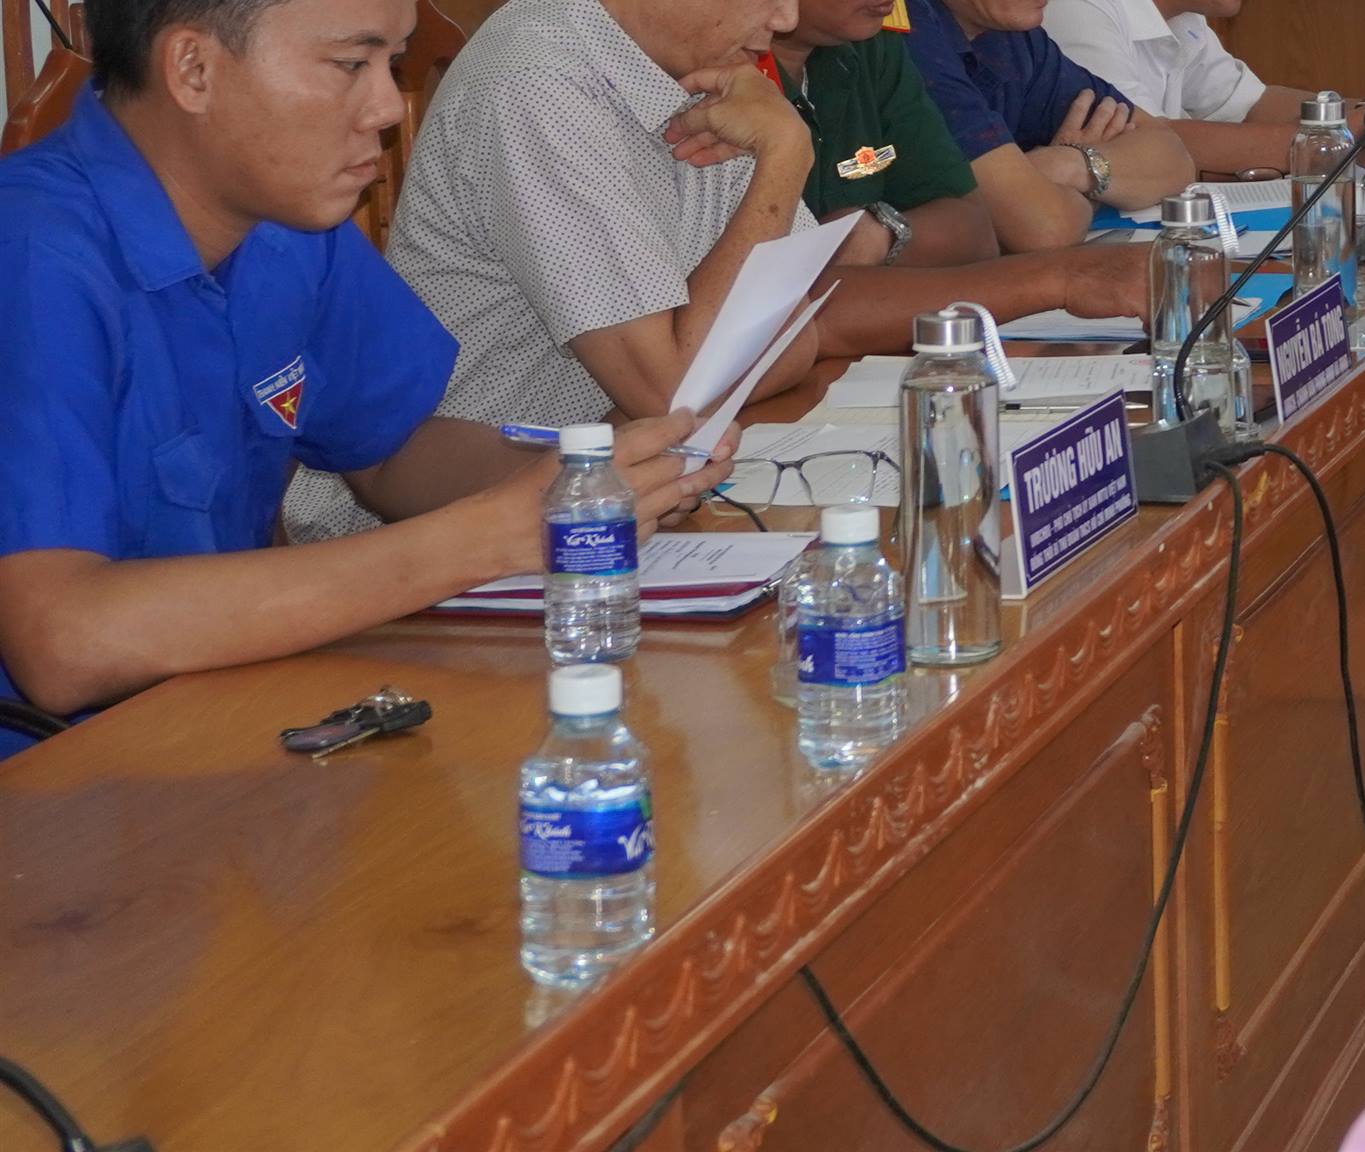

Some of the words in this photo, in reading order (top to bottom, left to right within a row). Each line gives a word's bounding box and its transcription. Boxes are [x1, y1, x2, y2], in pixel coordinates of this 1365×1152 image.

[1023, 445, 1078, 515] TRƯƠNG
[1076, 425, 1105, 482] HỮU
[1104, 418, 1124, 466] AN
